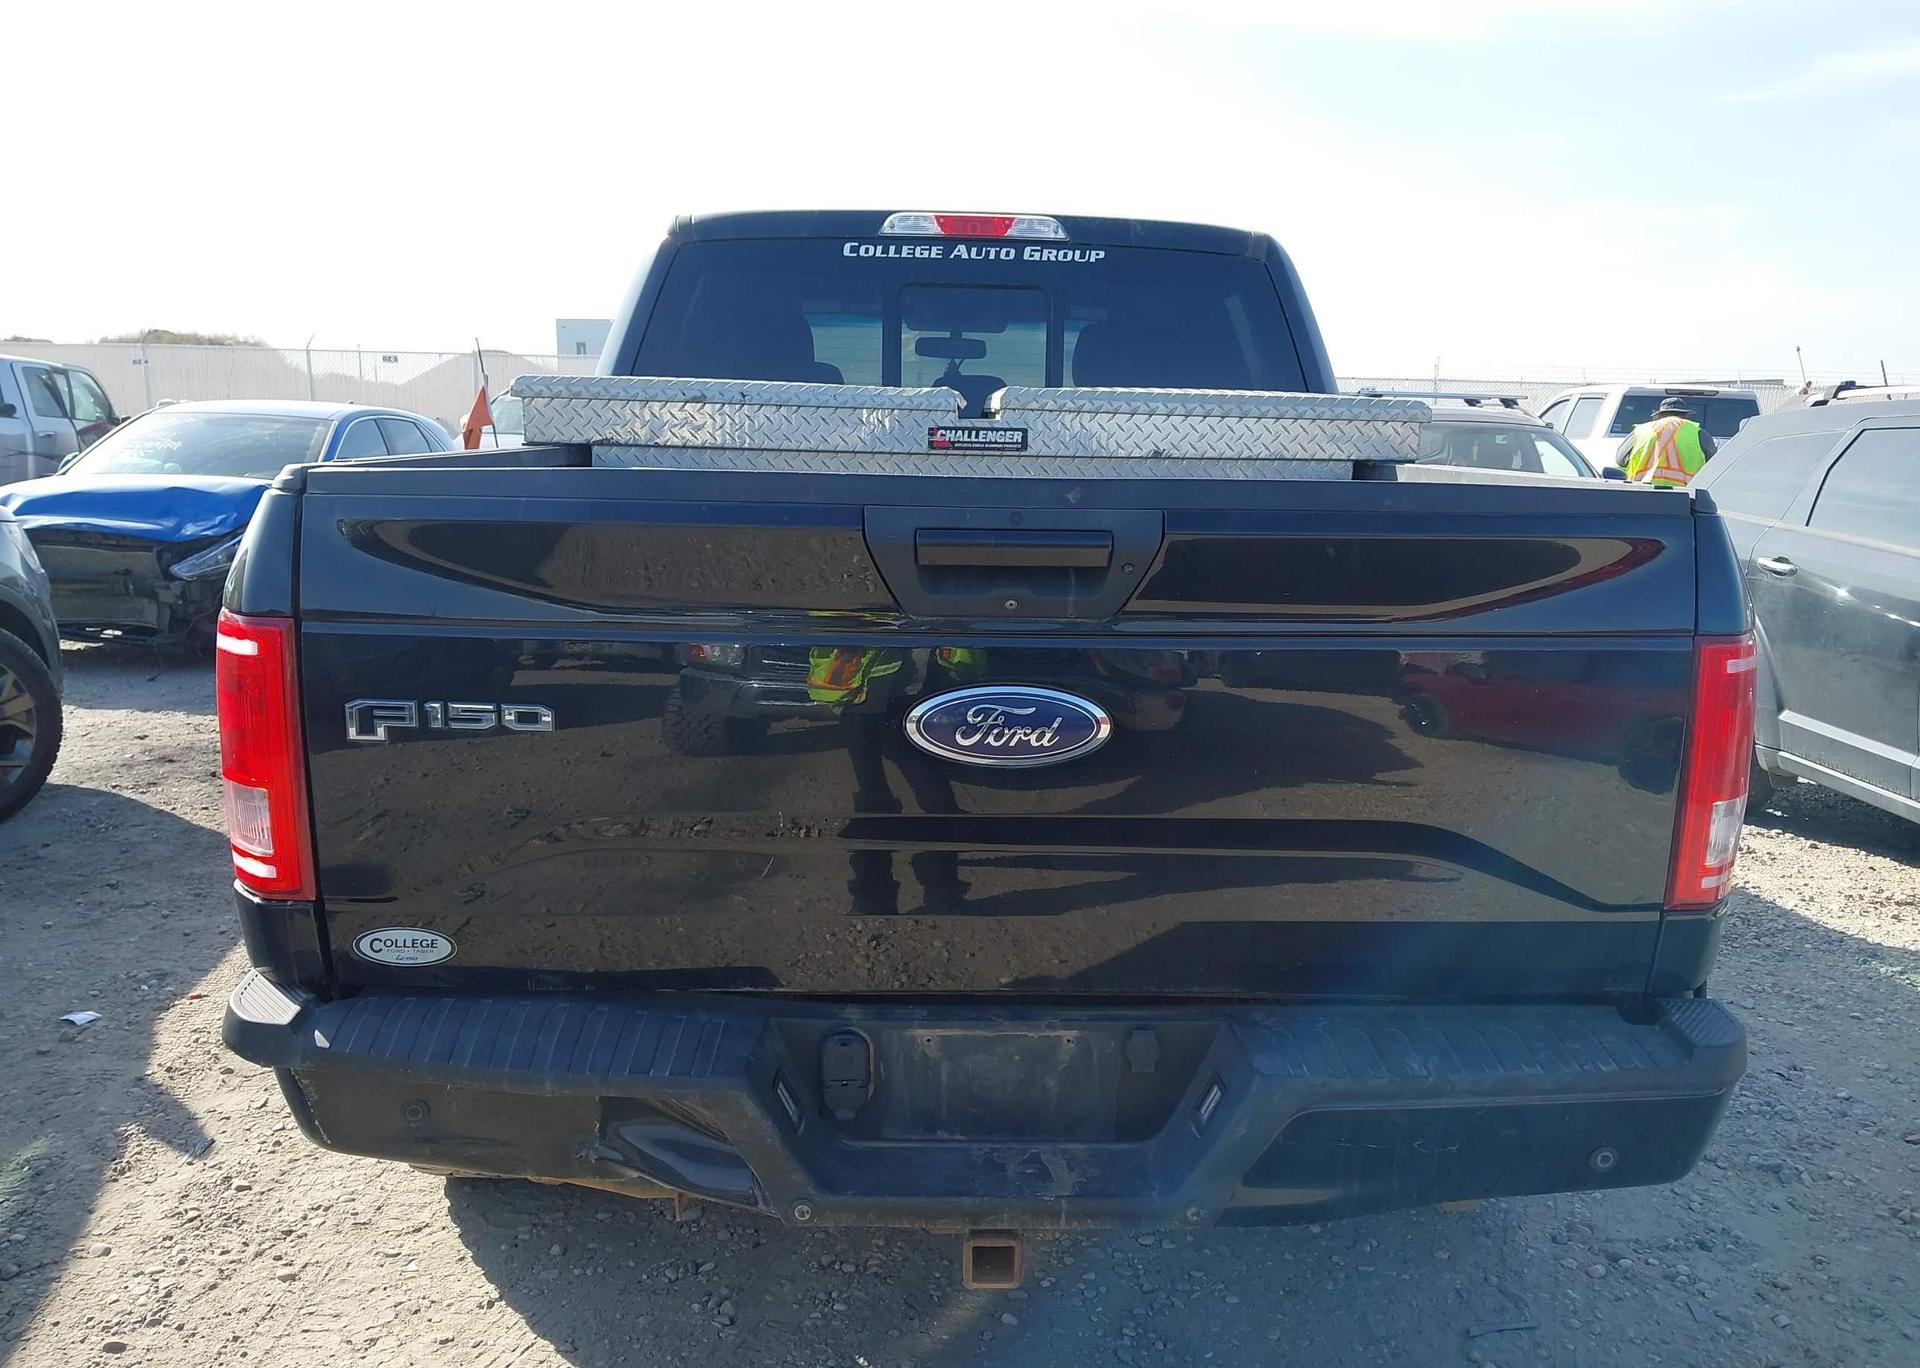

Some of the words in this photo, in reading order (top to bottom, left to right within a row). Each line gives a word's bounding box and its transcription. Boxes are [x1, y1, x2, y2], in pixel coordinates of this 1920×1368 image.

[842, 242, 944, 259] COLLEGE
[949, 244, 1016, 261] AUTO
[1023, 246, 1106, 263] GROUP
[936, 429, 1023, 443] CHALLENGER
[955, 704, 1063, 747] Ford
[369, 938, 439, 954] COLLEGE
